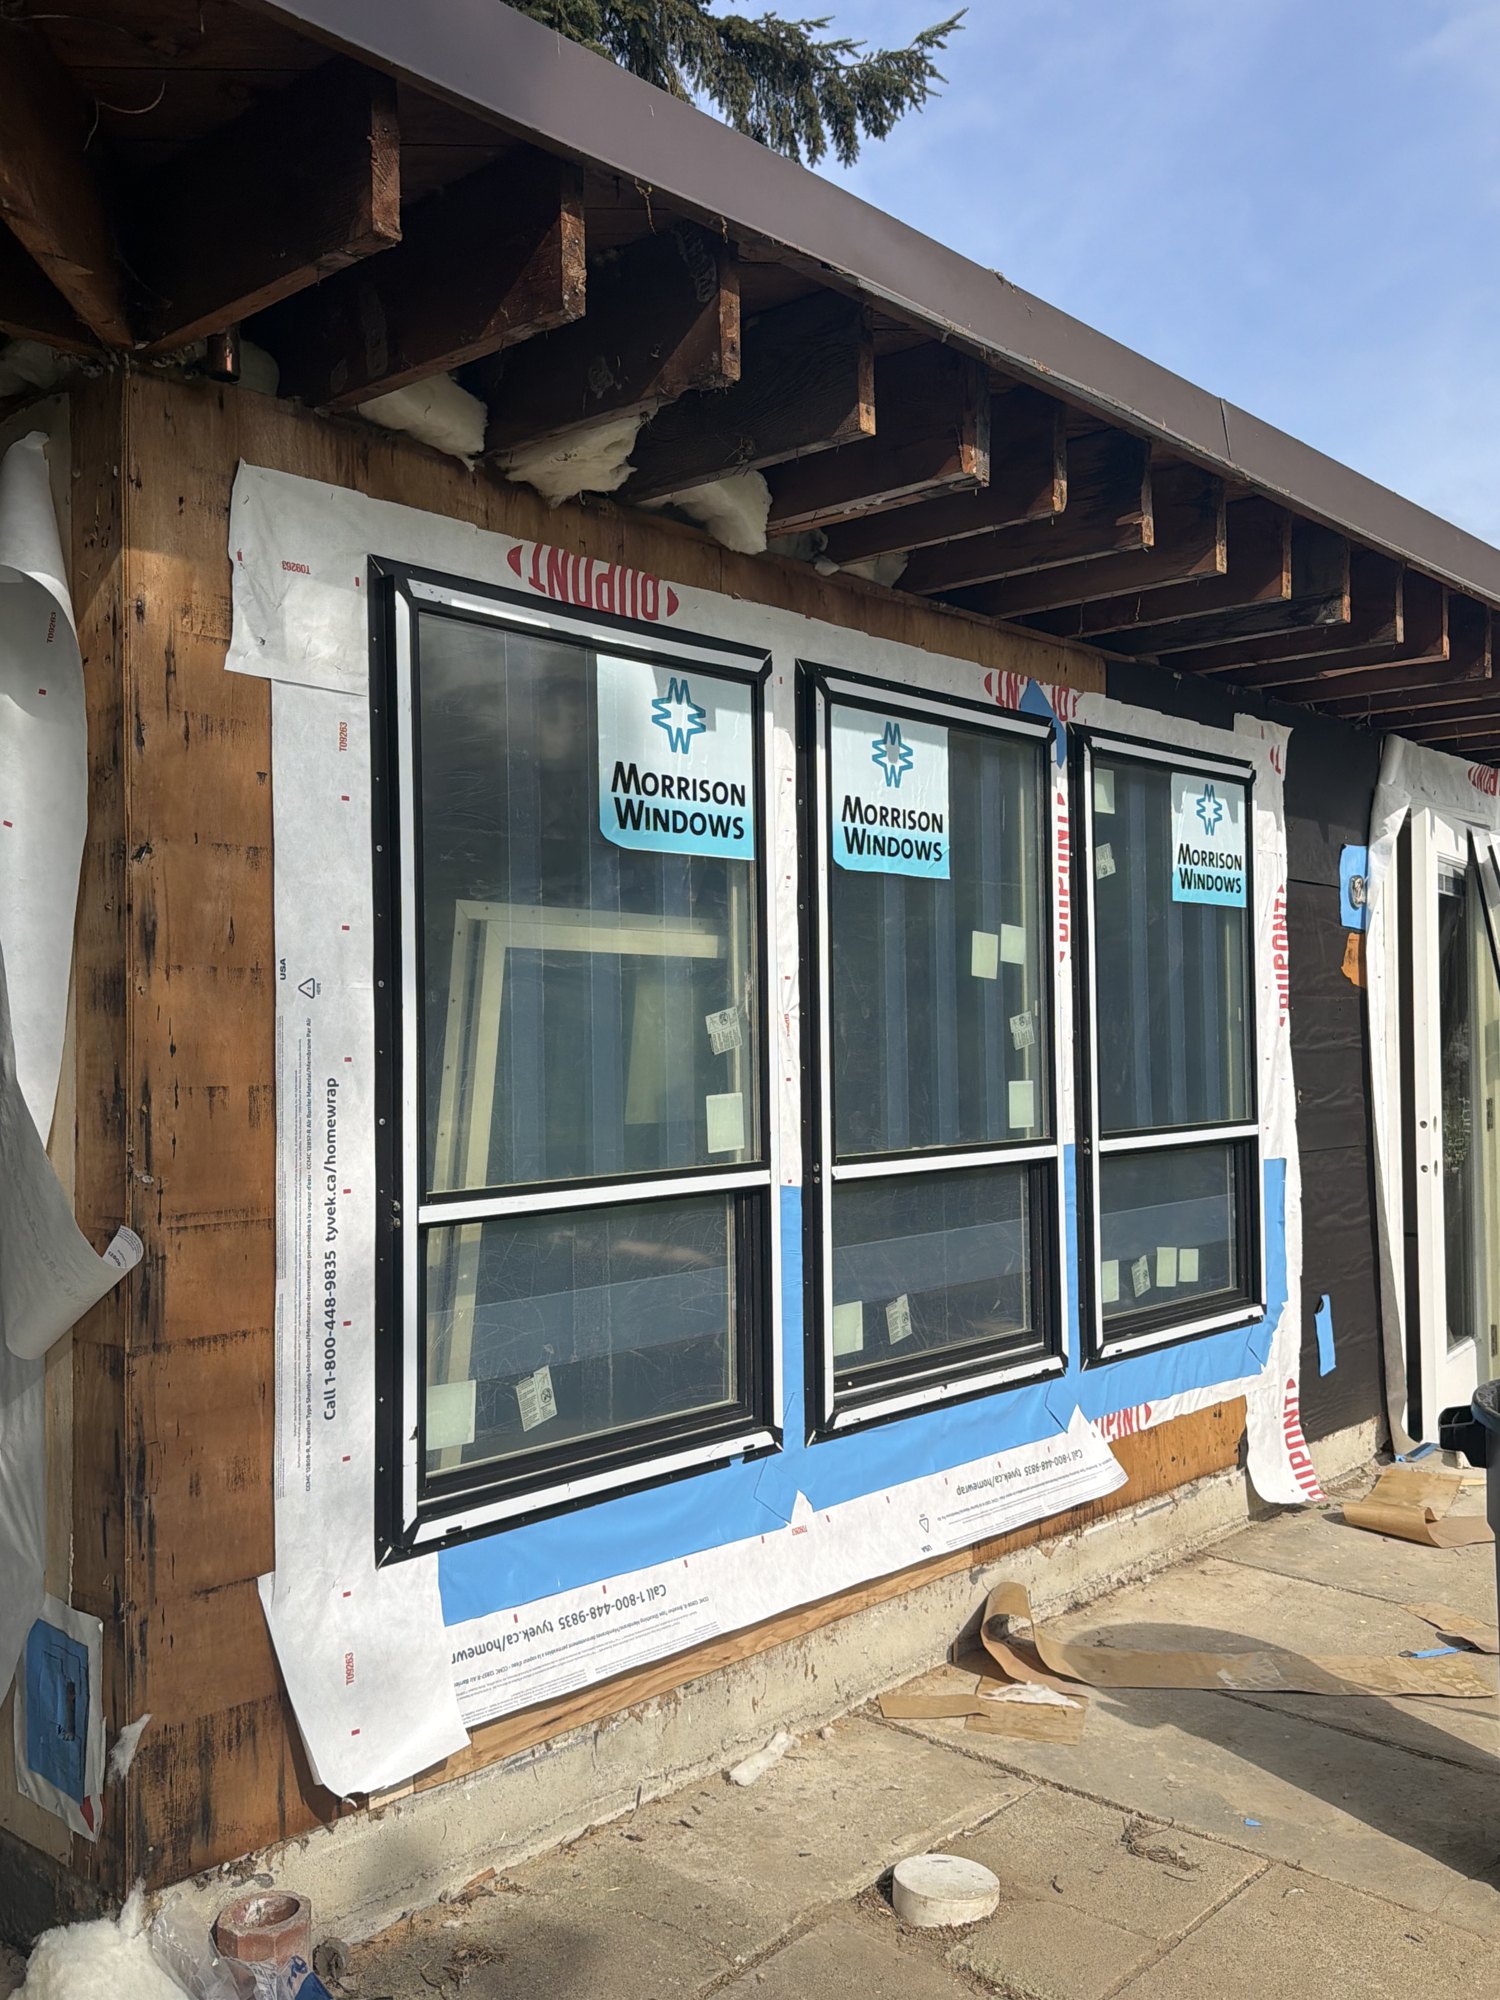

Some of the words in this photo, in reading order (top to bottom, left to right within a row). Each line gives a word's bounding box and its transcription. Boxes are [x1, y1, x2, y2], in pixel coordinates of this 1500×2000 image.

[282, 561, 311, 575] T09263
[338, 722, 348, 752] T09263
[611, 761, 746, 807] MORRISON
[613, 797, 746, 841] WINDOWS
[841, 795, 944, 834] MORRISON
[843, 826, 943, 862] WINDOWS
[1177, 843, 1242, 870] MORRISON
[1178, 867, 1242, 894] WINDOWS
[323, 1077, 340, 1242] tyvek.ca/homewrap
[323, 1251, 337, 1386] 1-800-448-9835
[323, 1388, 337, 1420] Call
[1024, 1454, 1070, 1476] 1-800-448-9835
[1070, 1449, 1083, 1460] Call
[1283, 1396, 1328, 1502] DUPONT
[956, 1468, 1022, 1496] tyvek.ca/homewrap
[646, 1583, 667, 1601] Call
[558, 1591, 645, 1630] 1-800-448-9835
[345, 1653, 354, 1685] T09263
